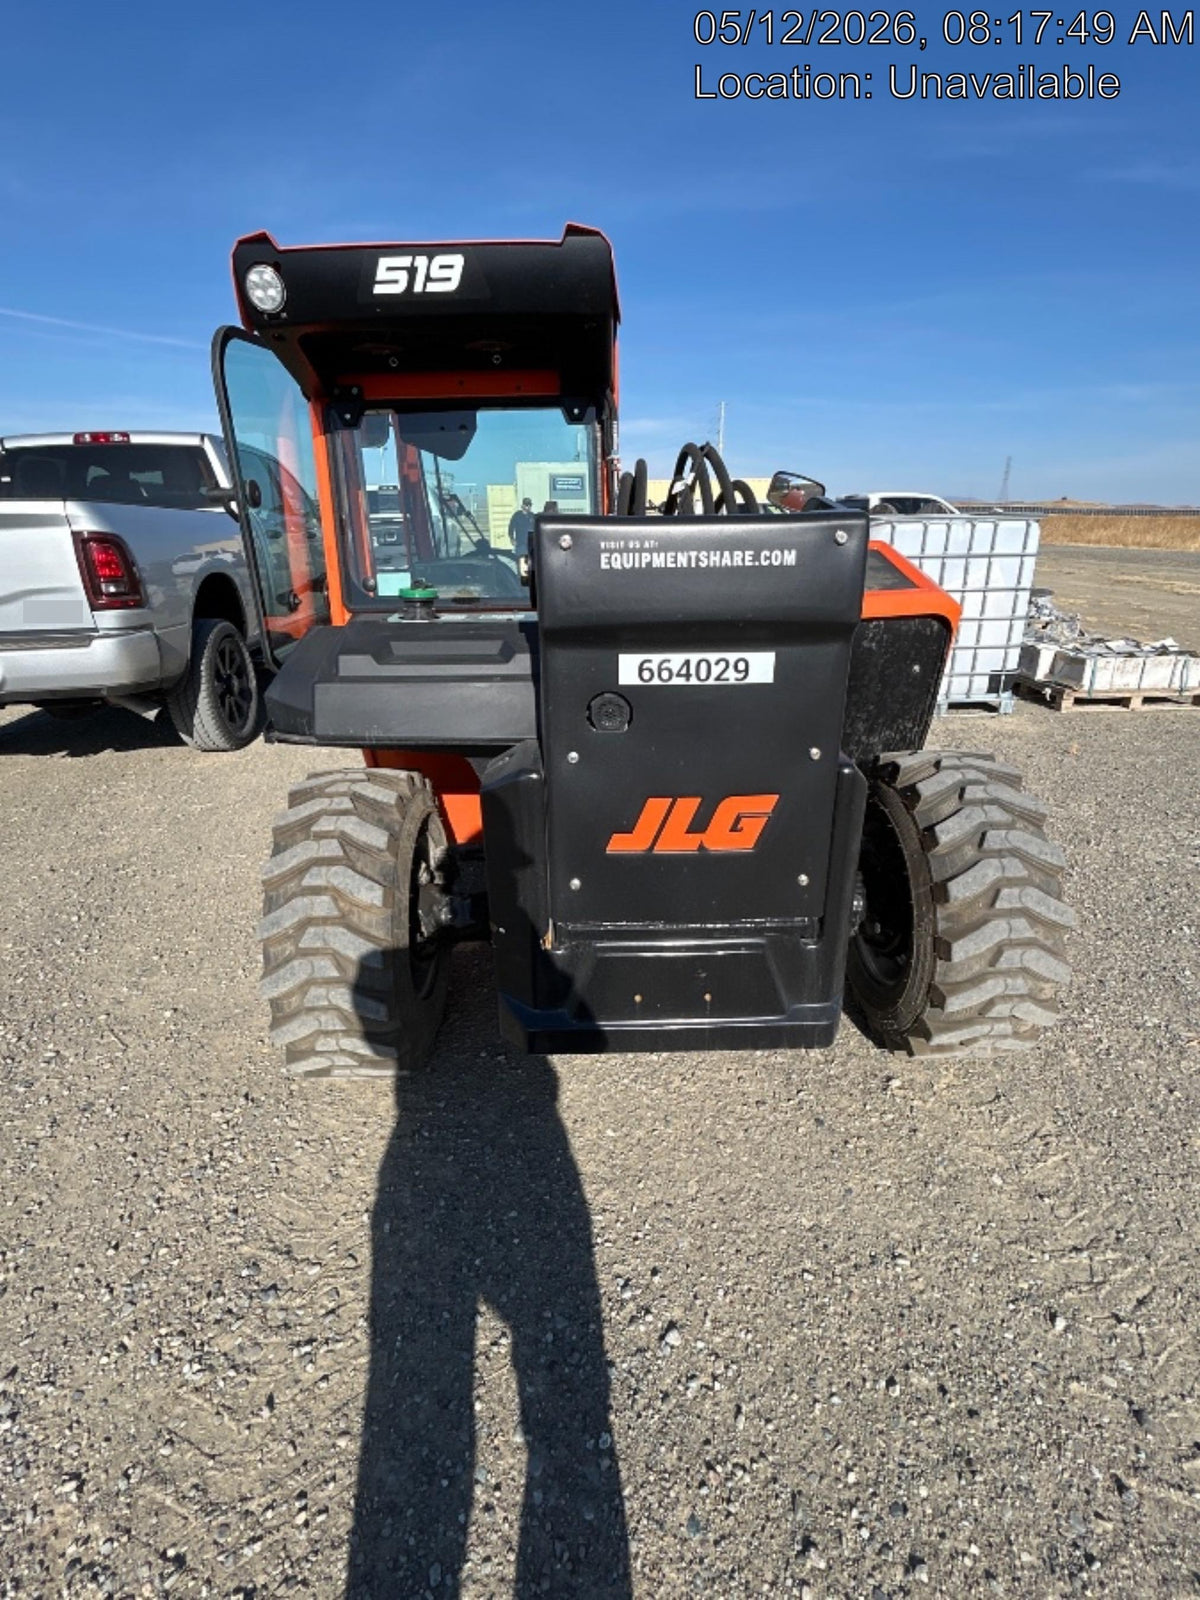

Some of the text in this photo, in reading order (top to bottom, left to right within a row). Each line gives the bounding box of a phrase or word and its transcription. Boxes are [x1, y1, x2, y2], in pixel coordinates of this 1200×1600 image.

[373, 253, 464, 294] 519
[600, 549, 797, 569] EQUIPMENTSHARE.COM
[638, 657, 750, 683] 664029
[606, 794, 780, 853] JLG
